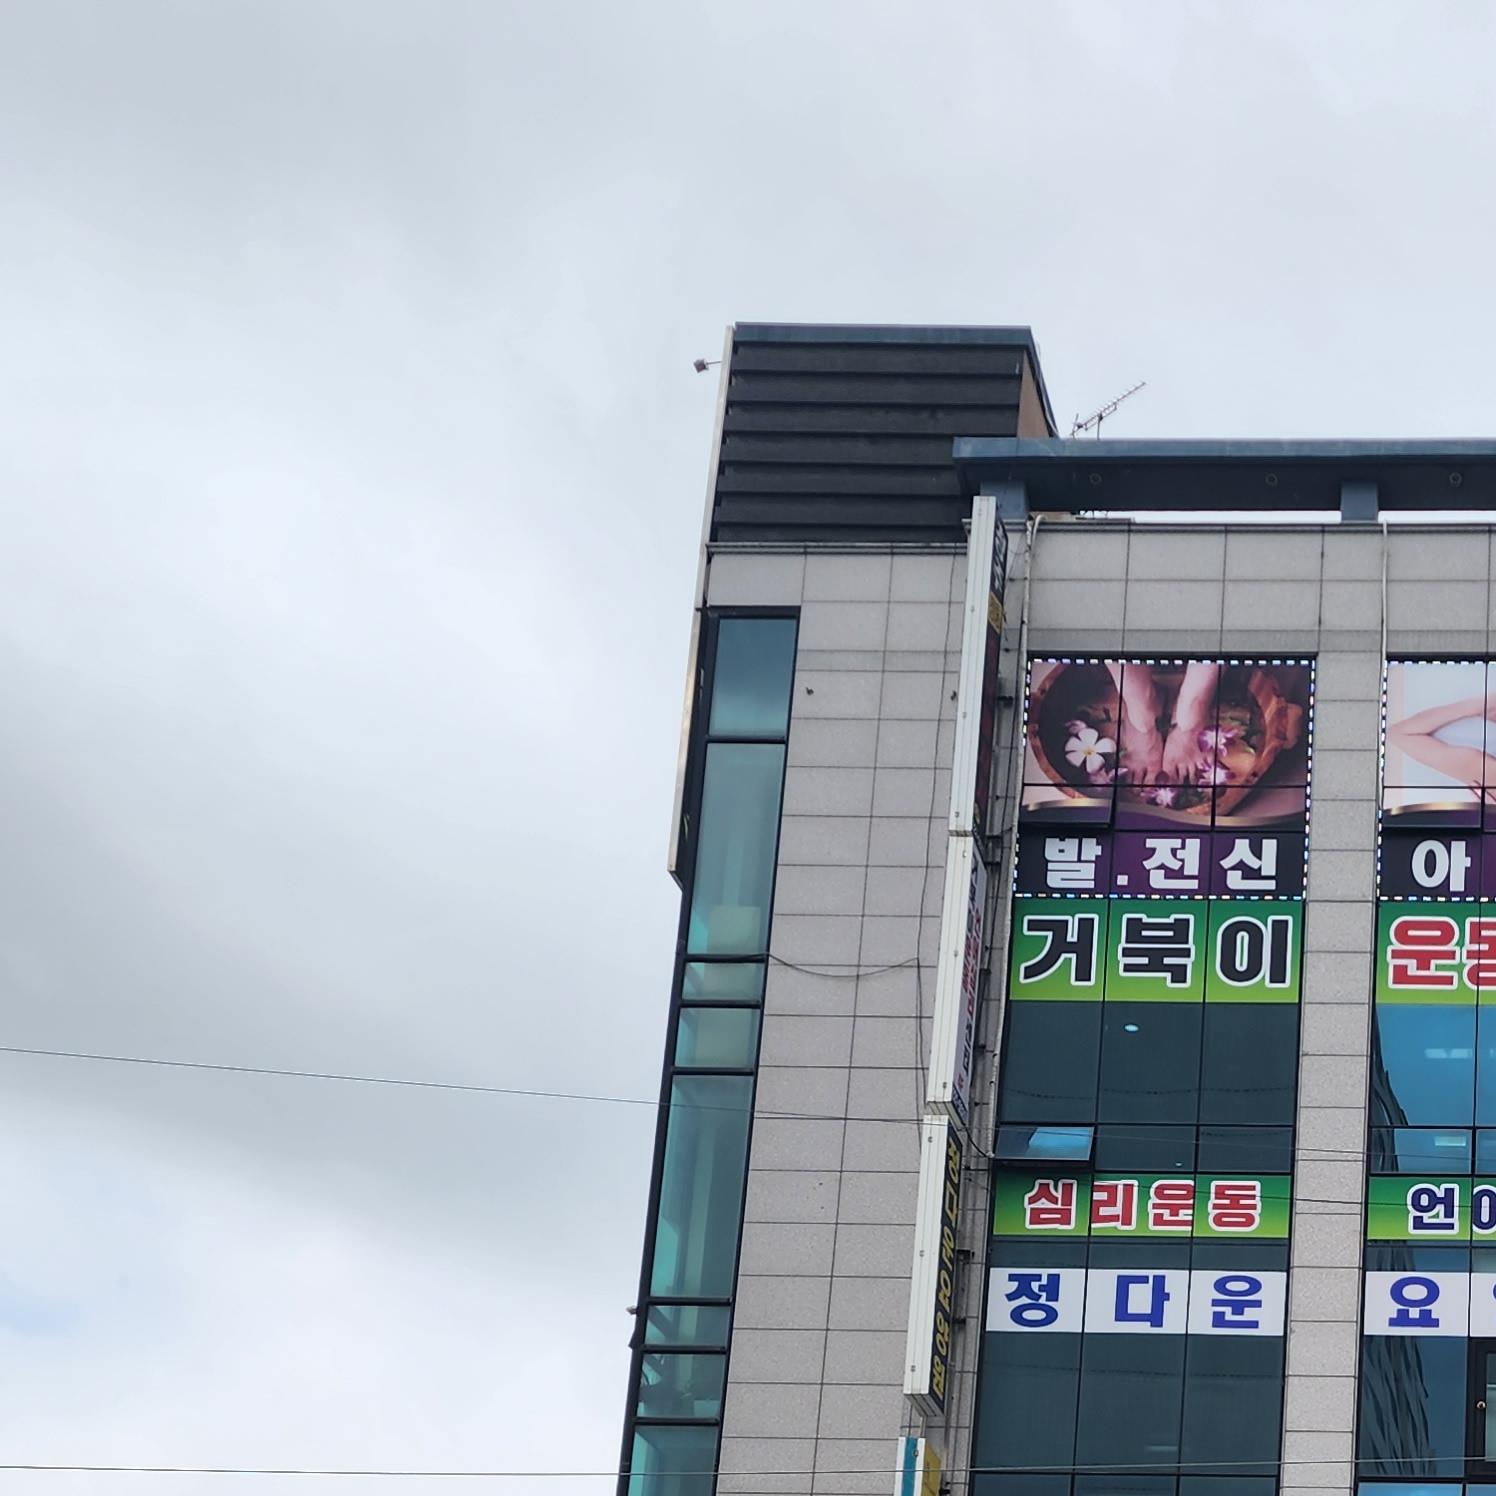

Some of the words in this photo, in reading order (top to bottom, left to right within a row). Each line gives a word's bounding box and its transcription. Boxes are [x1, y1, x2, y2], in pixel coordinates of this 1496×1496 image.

[1018, 913, 1293, 987] 거북이
[1023, 1178, 1261, 1232] 심리운동
[929, 1139, 963, 1402] 정다운요양원
[1004, 1273, 1262, 1329] 정다운
